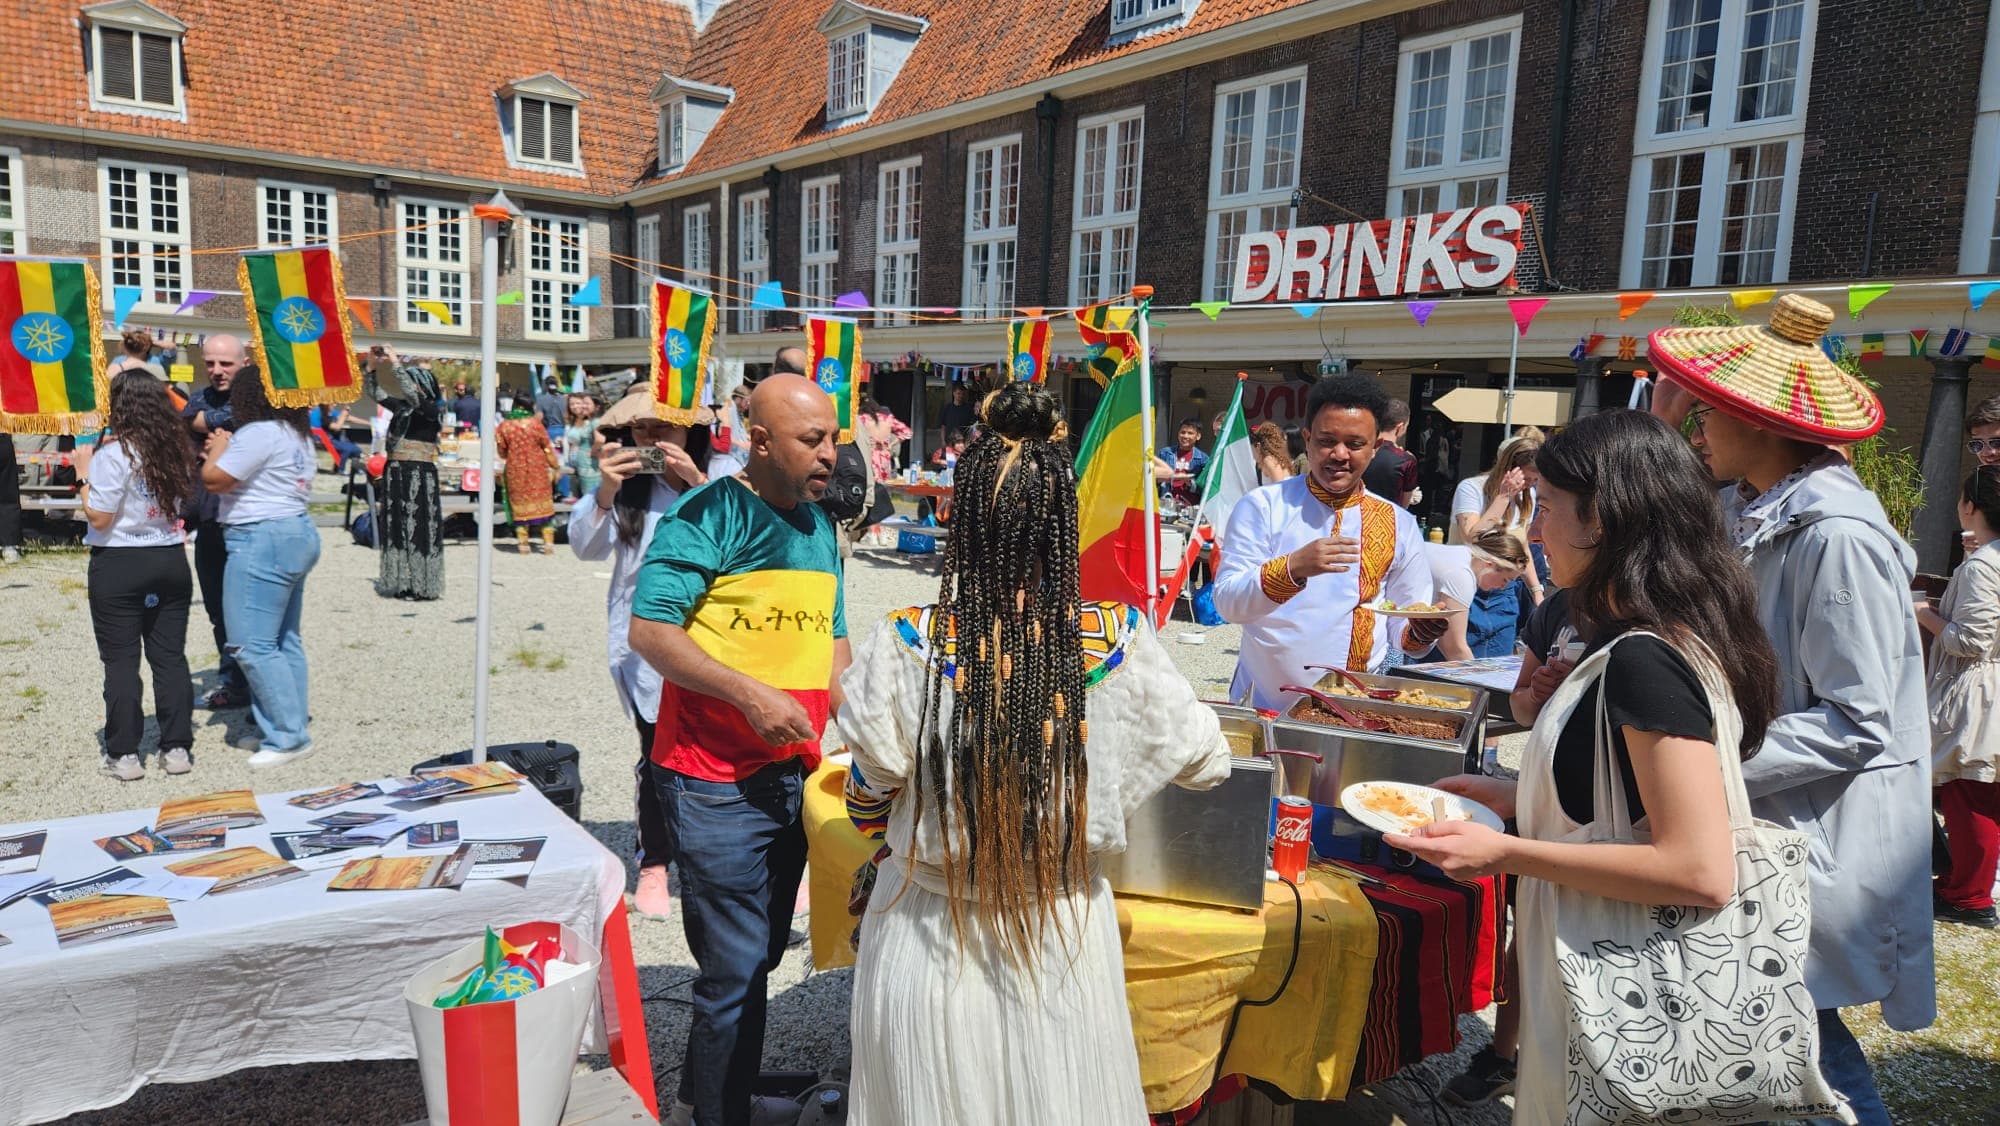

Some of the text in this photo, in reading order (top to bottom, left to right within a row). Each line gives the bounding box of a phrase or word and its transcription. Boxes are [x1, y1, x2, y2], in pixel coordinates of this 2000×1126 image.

[1232, 204, 1522, 303] DRINKS
[729, 606, 832, 637] ኢትዮጵ
[1276, 816, 1309, 842] Cola
